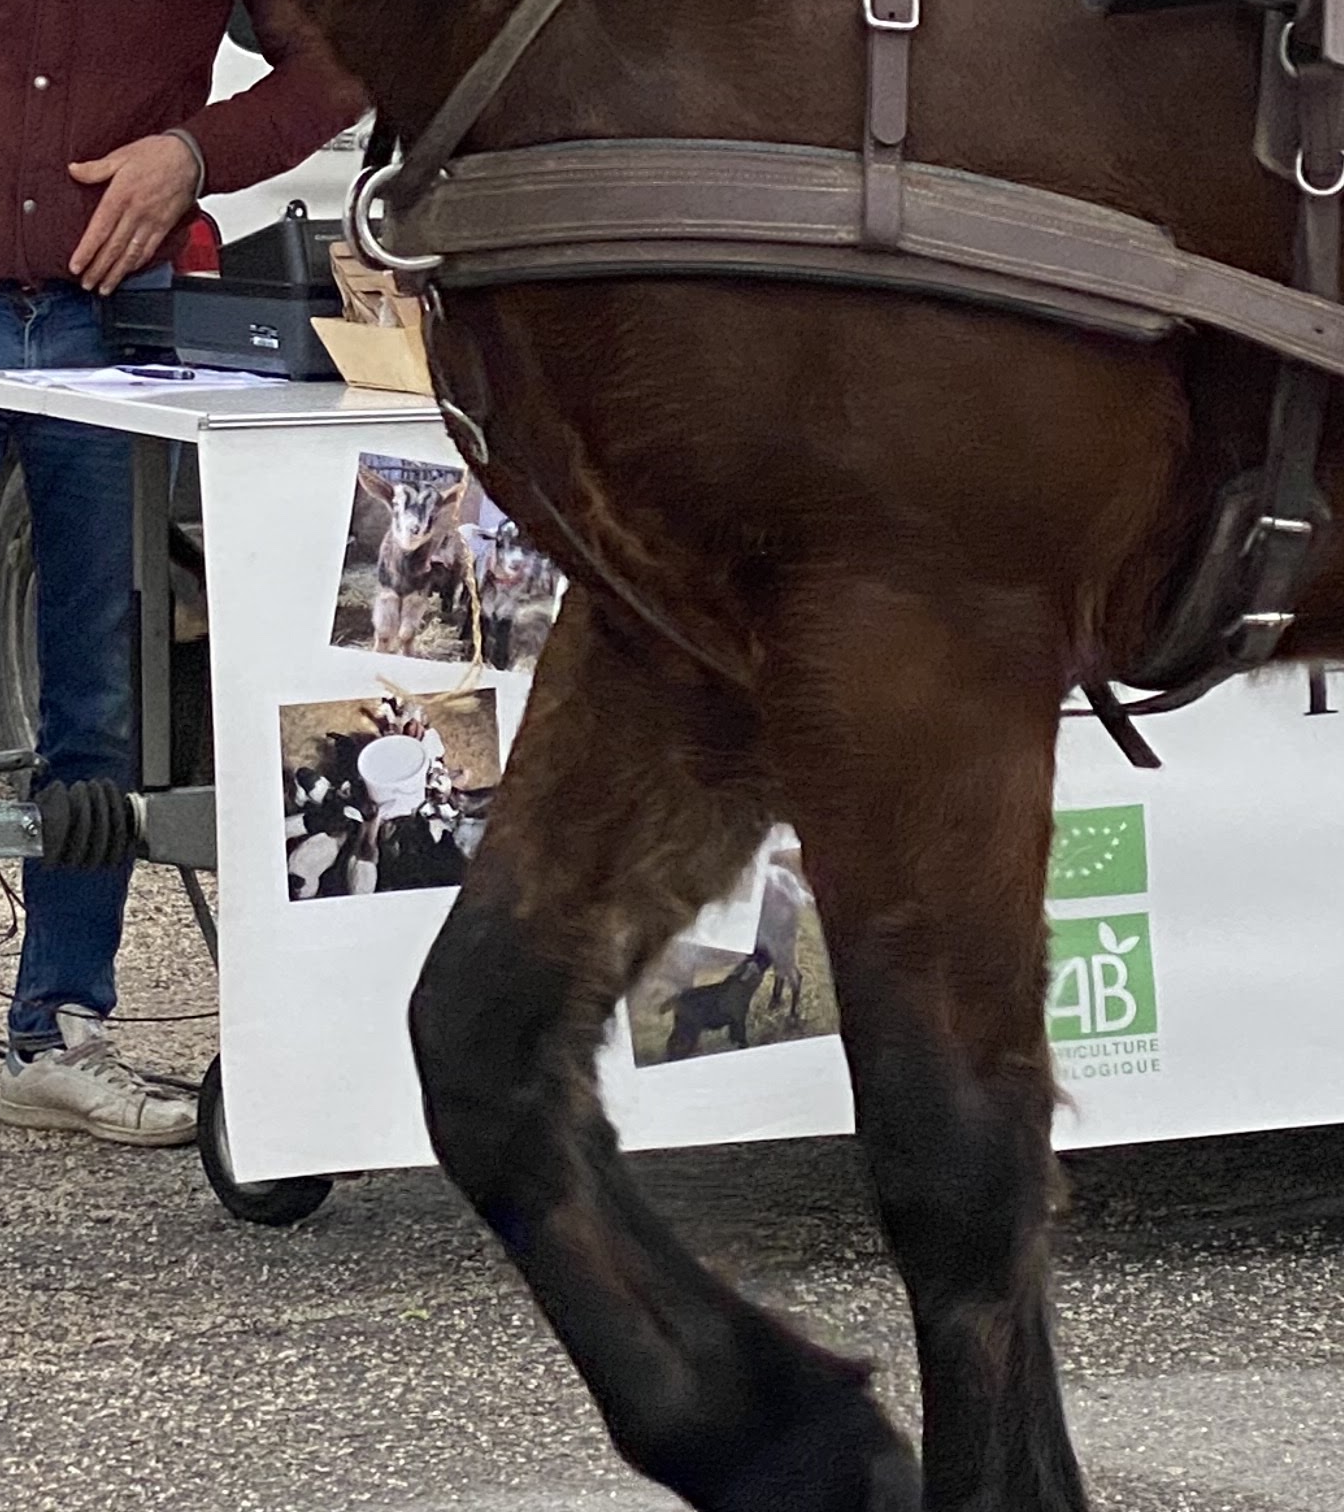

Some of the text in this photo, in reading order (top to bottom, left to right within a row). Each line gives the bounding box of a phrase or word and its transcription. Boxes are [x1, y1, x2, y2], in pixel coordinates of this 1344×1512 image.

[1045, 954, 1138, 1034] AB
[1060, 1040, 1159, 1061] CULTURE
[1064, 1059, 1160, 1080] LOGIQUE
